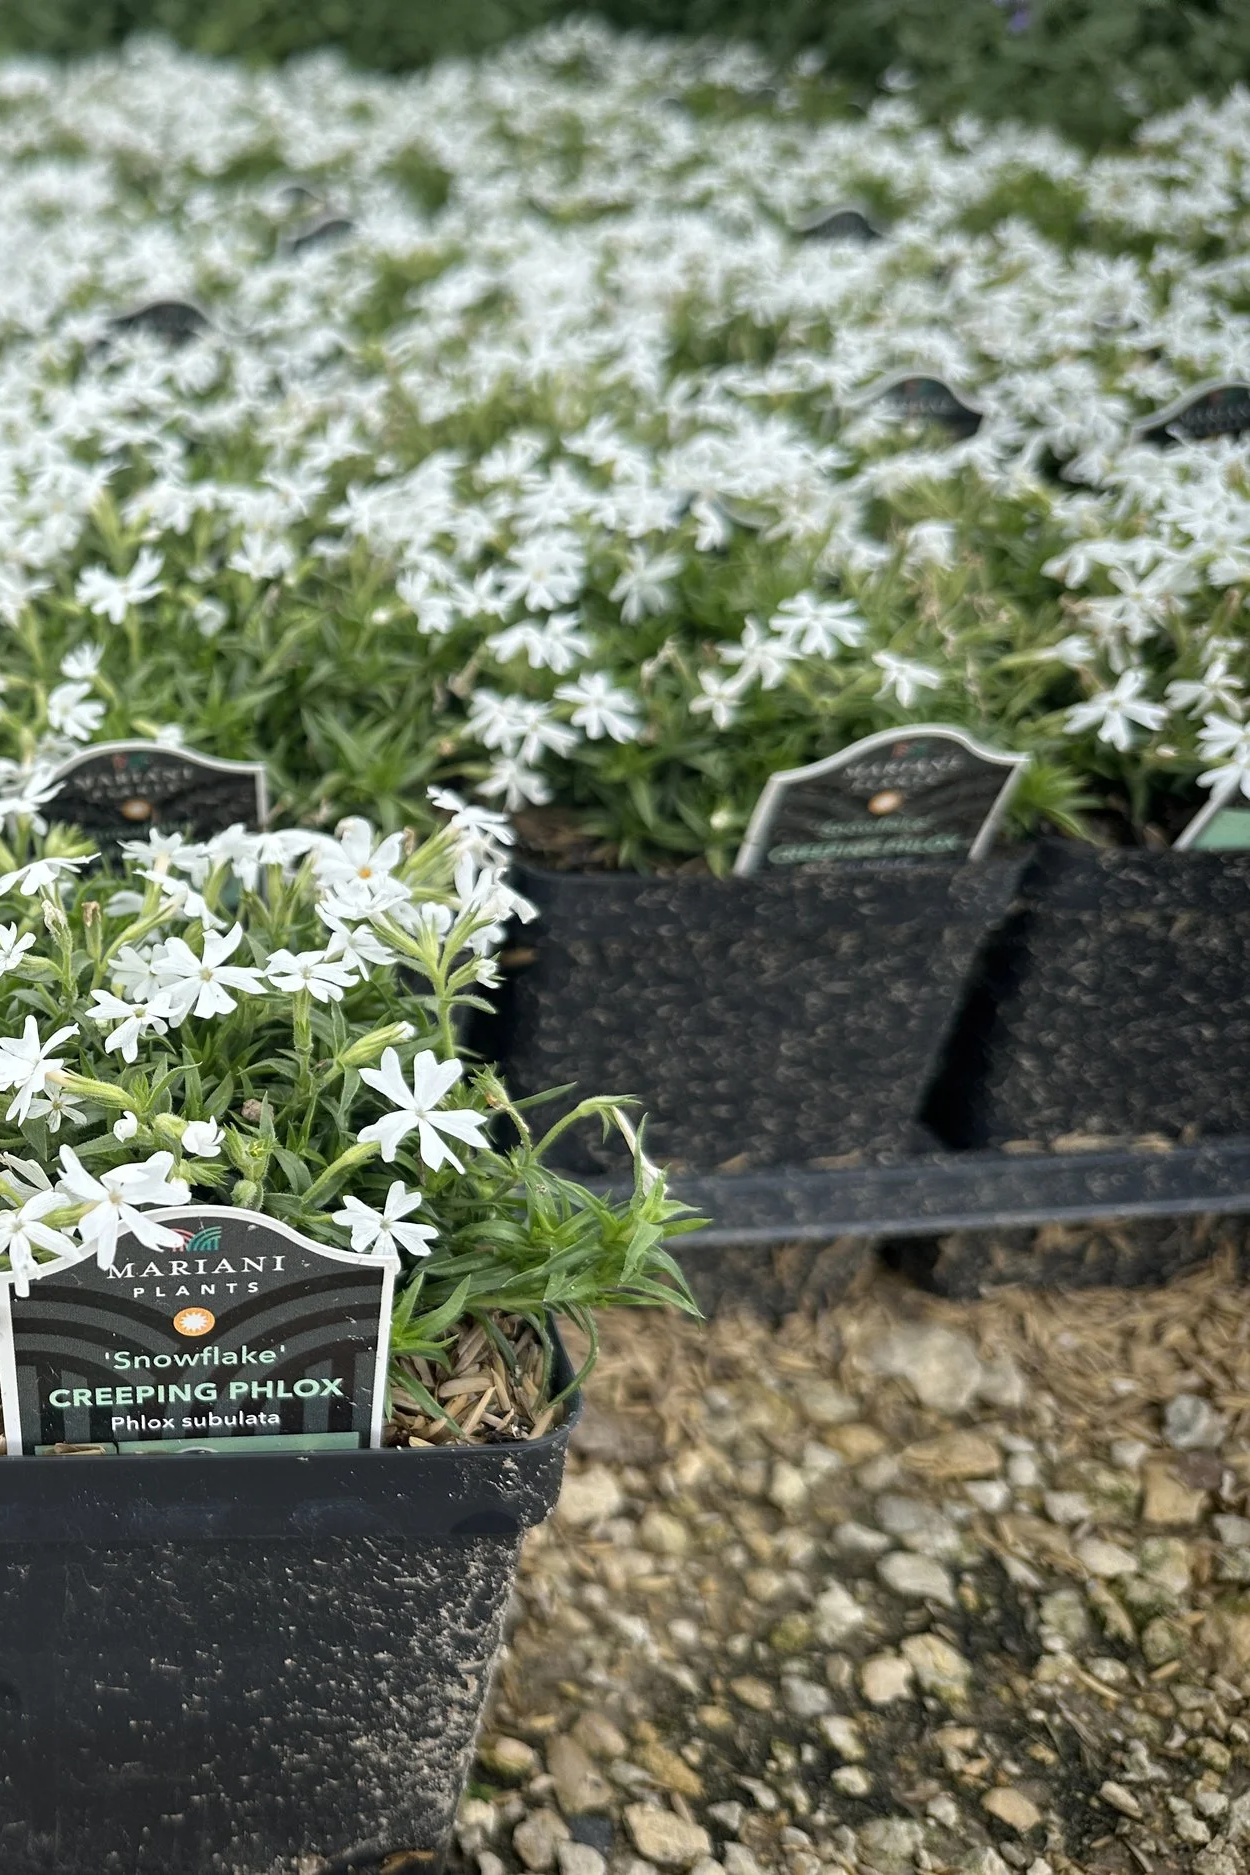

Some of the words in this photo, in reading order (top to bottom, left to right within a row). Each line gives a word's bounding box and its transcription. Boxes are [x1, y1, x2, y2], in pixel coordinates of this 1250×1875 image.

[107, 1255, 286, 1280] MARIANI
[133, 1281, 260, 1299] PLANTS
[104, 1344, 286, 1371] 'Snowflake'
[49, 1382, 218, 1408] CREEPING
[229, 1377, 345, 1400] PHLOX
[111, 1414, 175, 1431] Phlox
[181, 1410, 282, 1428] subulata
